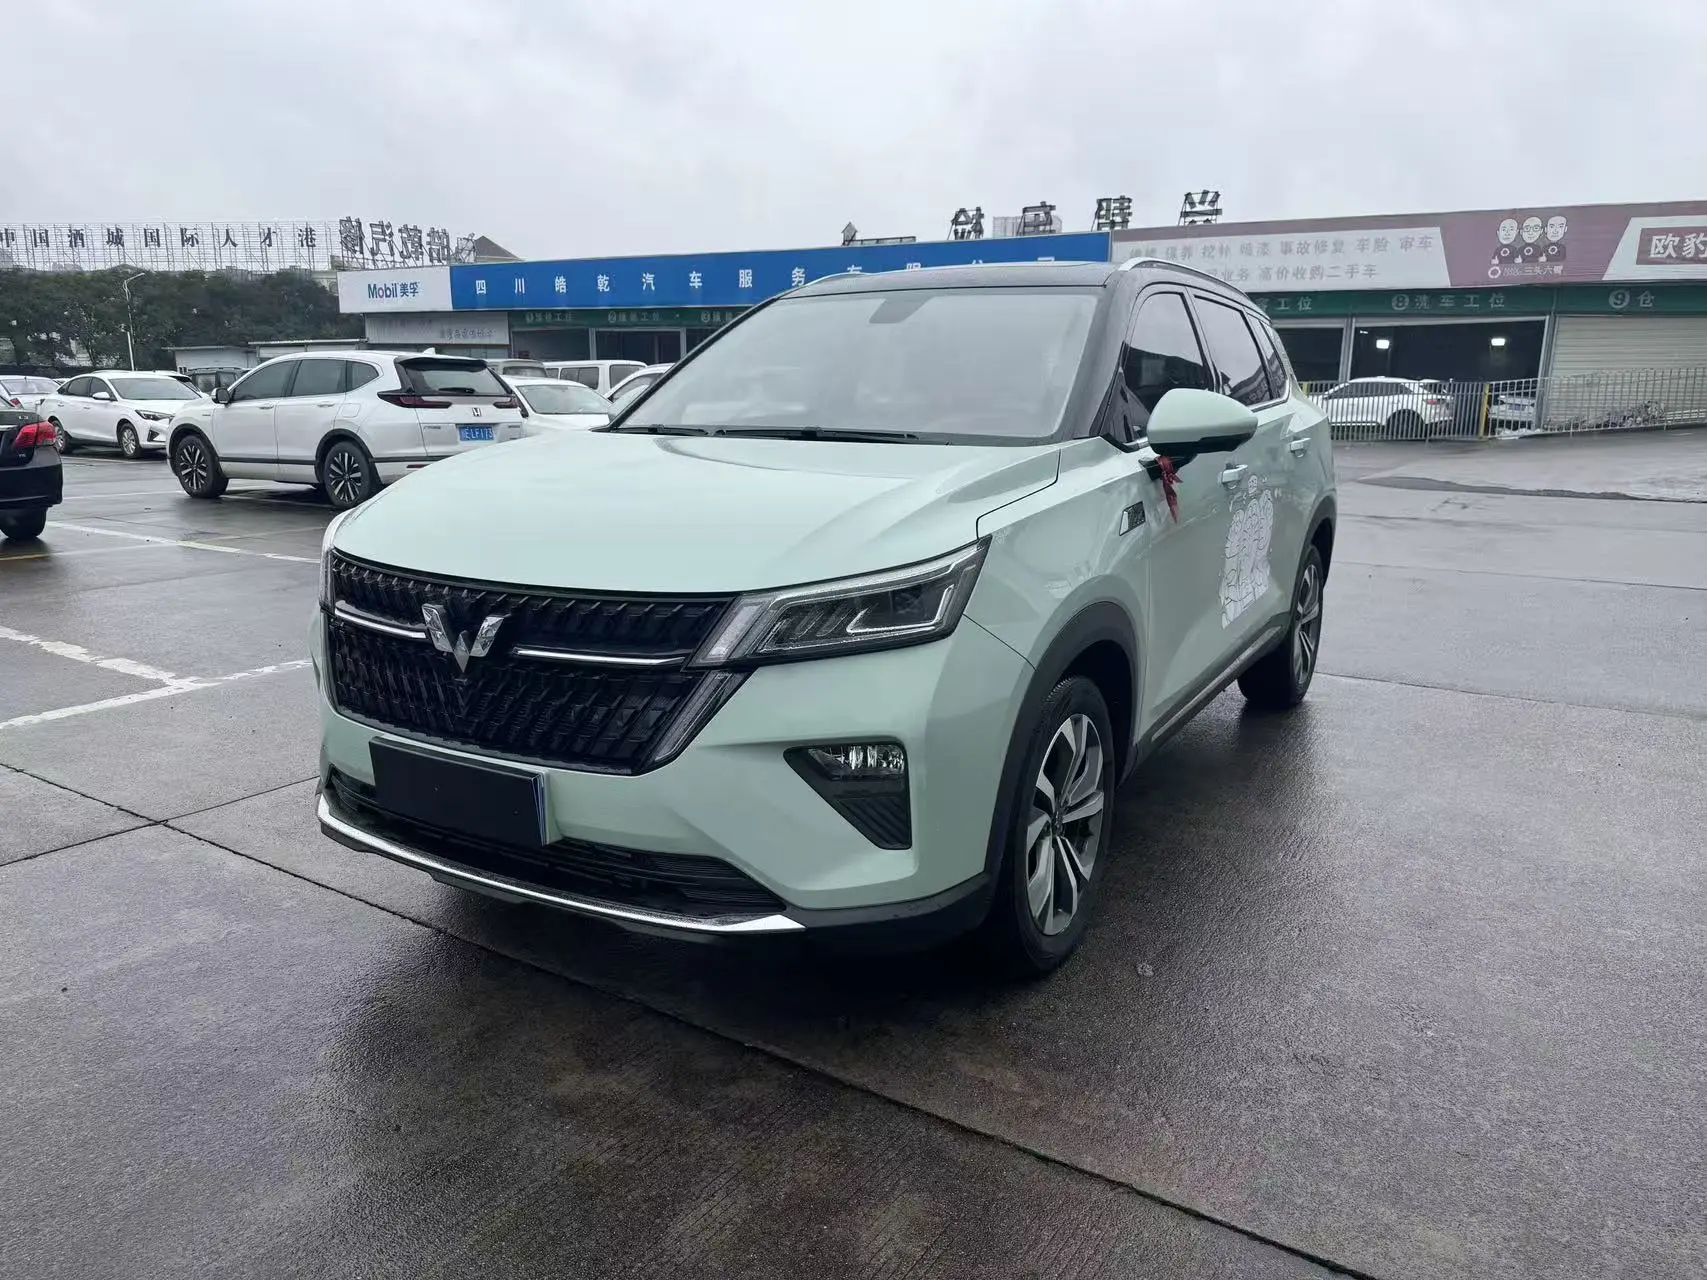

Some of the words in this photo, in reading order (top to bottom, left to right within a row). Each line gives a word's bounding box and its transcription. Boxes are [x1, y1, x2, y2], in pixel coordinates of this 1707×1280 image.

[0, 226, 317, 248] 中国酒城国际人才港
[1280, 239, 1345, 256] 事故修复
[1356, 237, 1389, 253] 车险
[1399, 235, 1434, 252] 审车
[1259, 264, 1378, 281] 高价收购二手车
[368, 282, 397, 299] Mobil
[400, 281, 419, 298] 美孚
